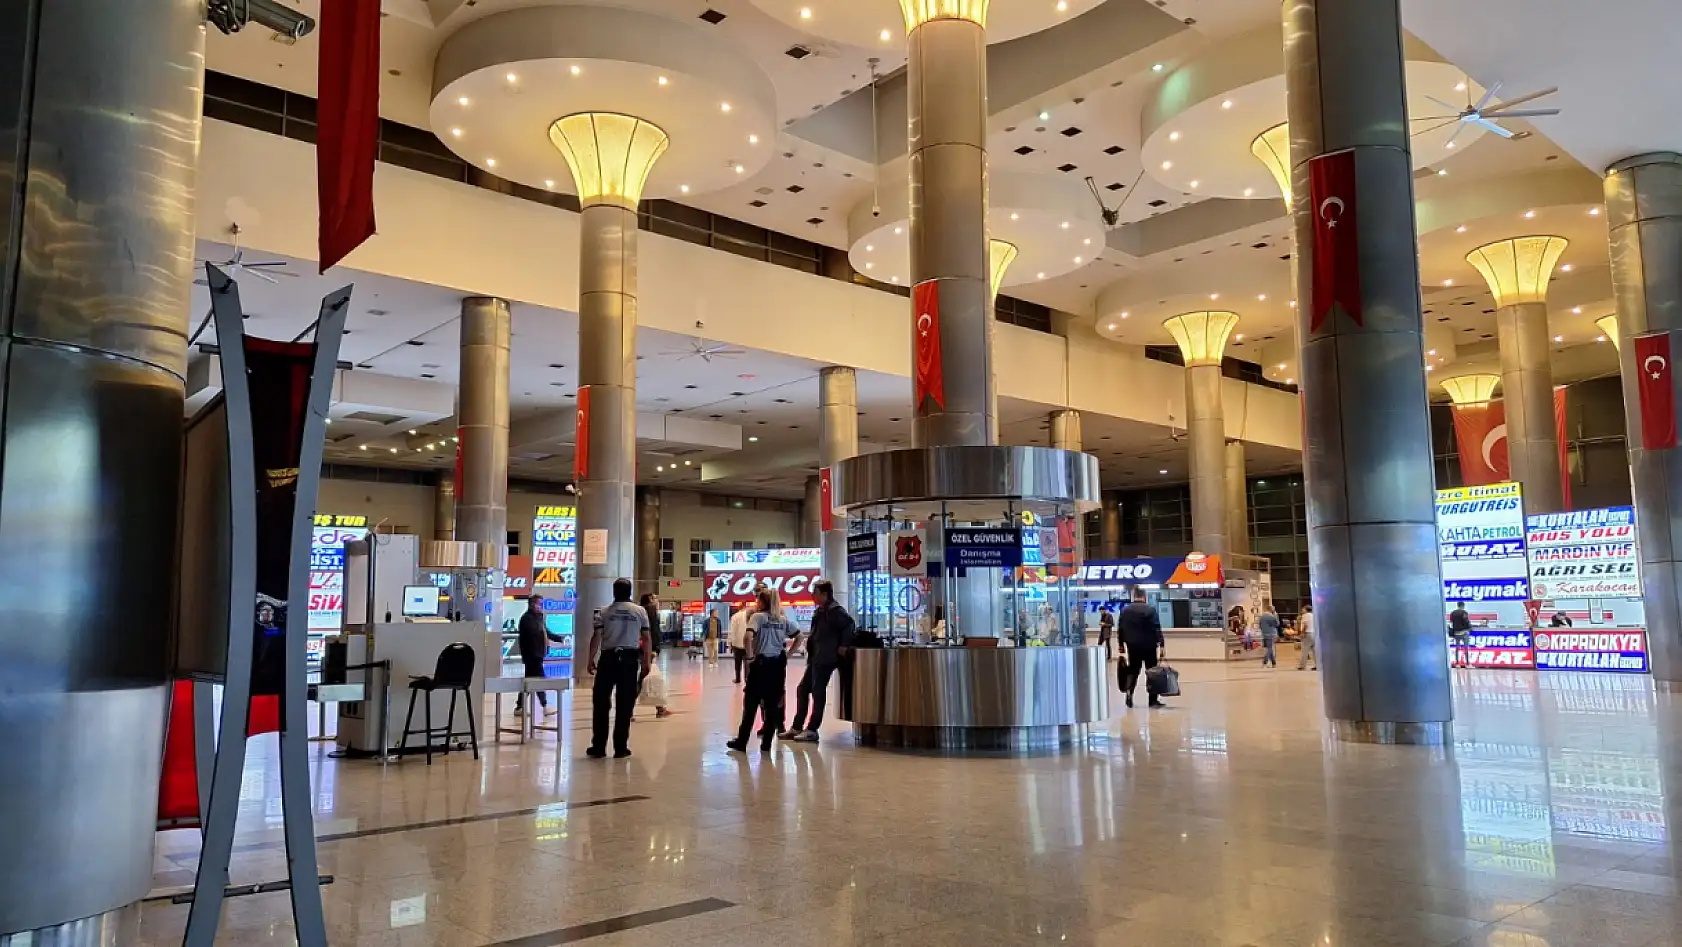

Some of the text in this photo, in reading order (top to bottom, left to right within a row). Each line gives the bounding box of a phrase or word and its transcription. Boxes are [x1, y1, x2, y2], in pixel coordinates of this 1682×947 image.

[951, 532, 972, 544] ÖZEL
[973, 532, 1015, 544] GÜVENLİK
[1482, 525, 1523, 539] PETROL
